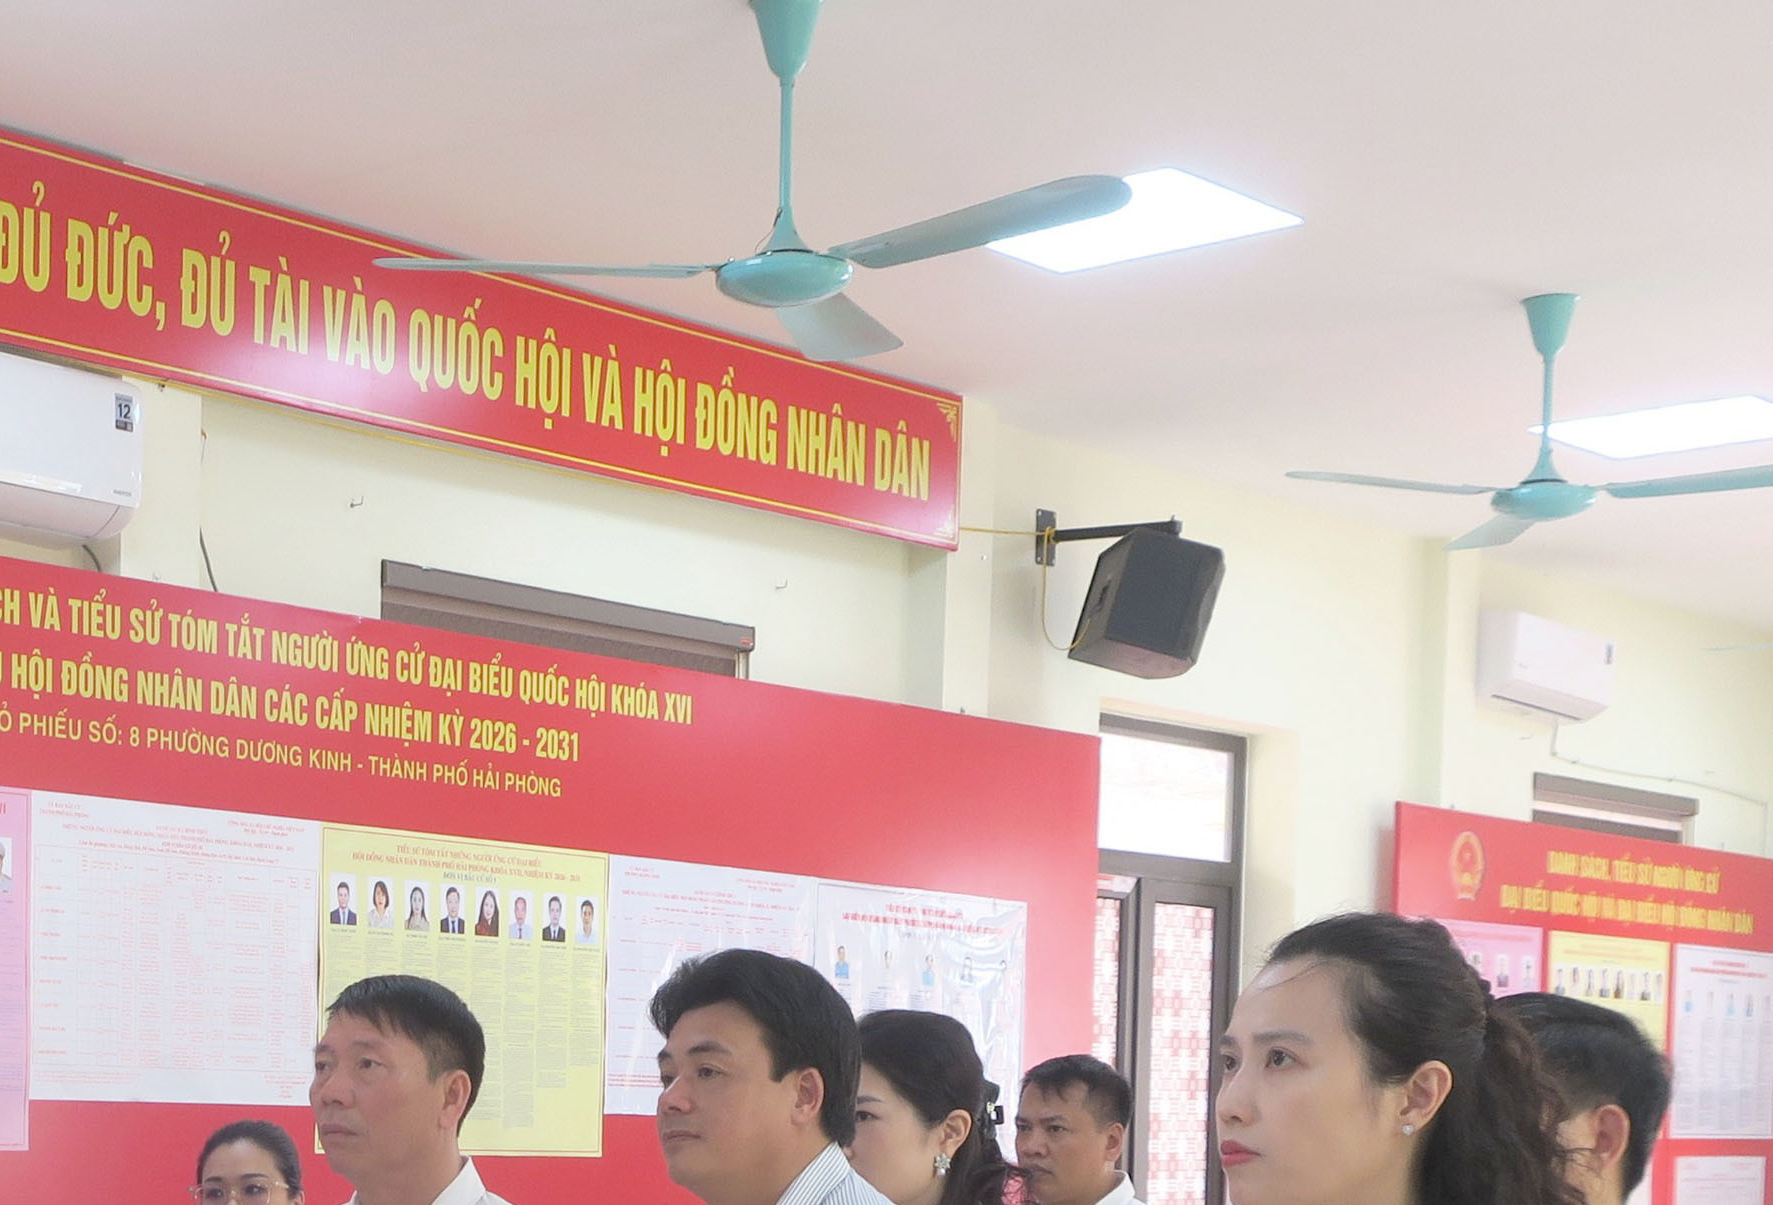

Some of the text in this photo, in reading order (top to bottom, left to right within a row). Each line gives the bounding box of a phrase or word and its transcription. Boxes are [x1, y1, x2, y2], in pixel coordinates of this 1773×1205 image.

[66, 208, 166, 331] ĐỨC,
[180, 231, 234, 336] ĐỦ
[250, 255, 309, 356] TÀI
[324, 276, 394, 374] VÀO
[409, 298, 503, 401] QUỐC
[515, 330, 571, 429] HỘI
[583, 343, 623, 430] VÀ
[634, 360, 685, 457] HỘI
[695, 365, 778, 467] ĐỒNG
[787, 402, 865, 487] NHÂN
[875, 419, 930, 502] DÂN
[118, 402, 132, 420] 12
[11, 649, 53, 702] HỘI
[62, 649, 128, 703] ĐỒNG
[137, 675, 203, 712] NHÂN
[210, 676, 257, 720] DÂN
[264, 687, 308, 726] CÁC
[315, 689, 358, 733] CẤP
[364, 700, 432, 747] NHIỆM
[438, 712, 463, 747] KỲ
[470, 718, 517, 754] 2026
[536, 728, 579, 761] 2031
[27, 584, 60, 631] VÀ
[68, 588, 120, 640] TIỂU
[129, 599, 161, 645] SỬ
[168, 606, 217, 655] TÓM
[226, 615, 264, 661] TẮT
[272, 629, 338, 673] NGƯỜI
[346, 637, 388, 680] ỨNG
[396, 641, 423, 684] CỬ
[429, 655, 462, 699] ĐẠI
[469, 653, 513, 698] BIỂU
[519, 663, 569, 708] QUỐC
[575, 672, 604, 718] HỘI
[612, 676, 659, 720] KHÓA
[664, 693, 693, 724] XVI
[19, 704, 82, 740] PHIẾU
[88, 715, 122, 746] SỐ:
[129, 729, 140, 748] 8
[147, 728, 228, 758] PHƯỜNG
[236, 739, 303, 766] DƯƠNG
[309, 750, 352, 772] KINH
[369, 751, 427, 782] THÀNH
[434, 759, 468, 785] PHỐ
[472, 759, 500, 790] HẢI
[505, 769, 562, 797] PHÒNG
